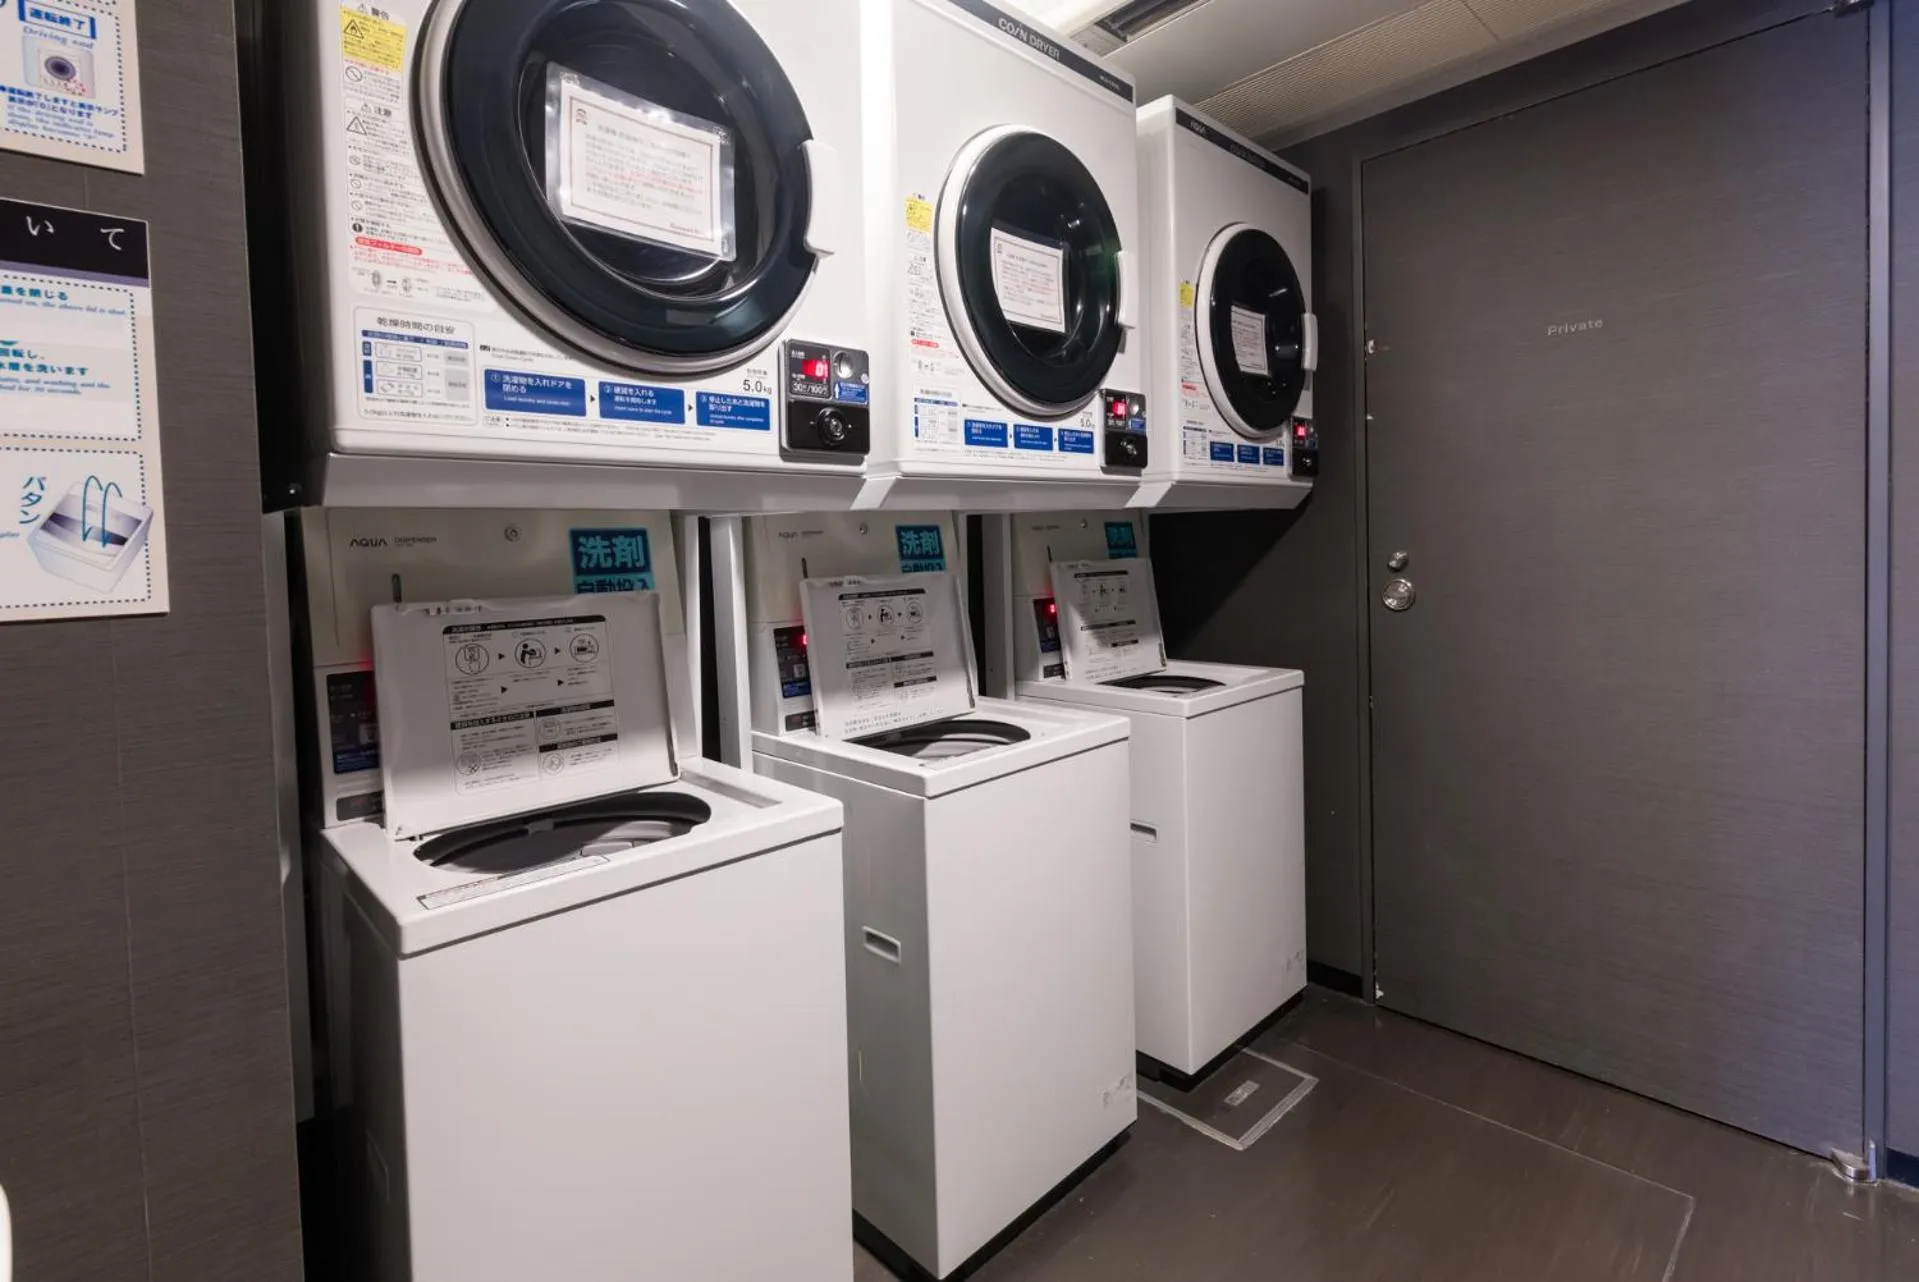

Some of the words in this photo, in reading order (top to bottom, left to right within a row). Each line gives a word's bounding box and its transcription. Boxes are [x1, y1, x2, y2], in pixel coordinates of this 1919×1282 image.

[998, 18, 1029, 42] COIN
[1029, 34, 1060, 61] DRYER
[1546, 319, 1604, 336] Private
[350, 537, 388, 547] AQUA
[577, 535, 645, 568] 洗剤
